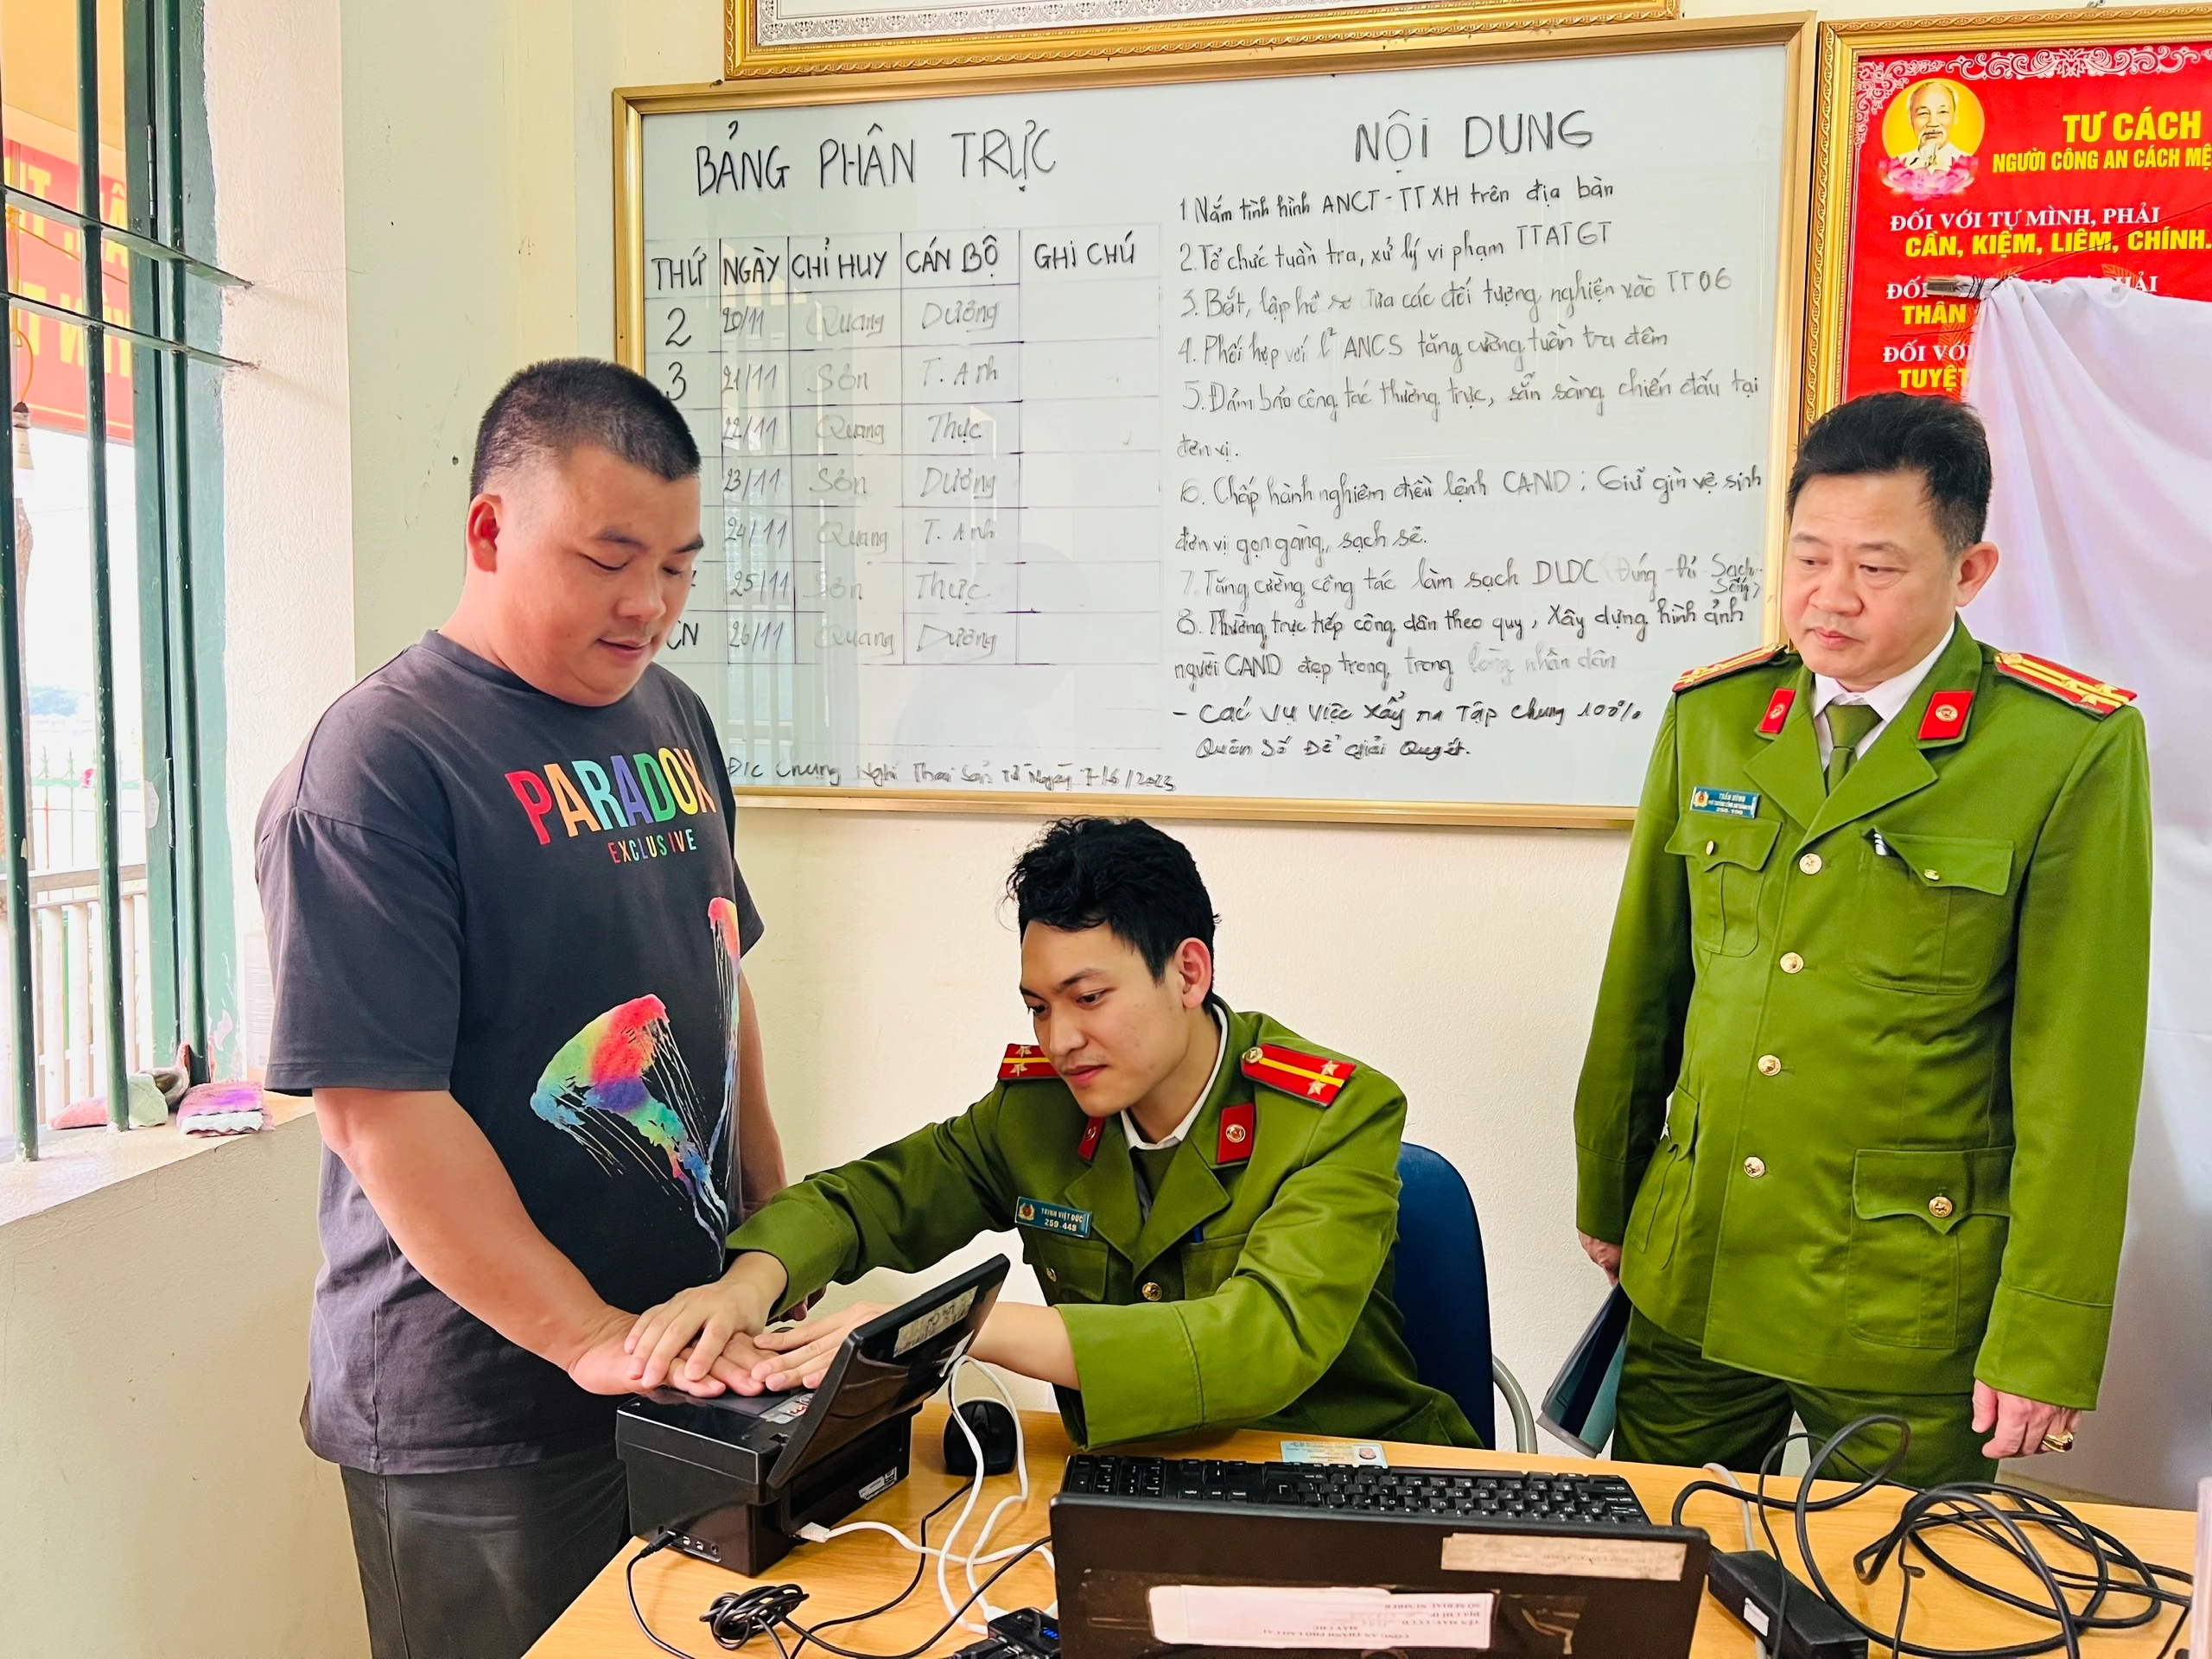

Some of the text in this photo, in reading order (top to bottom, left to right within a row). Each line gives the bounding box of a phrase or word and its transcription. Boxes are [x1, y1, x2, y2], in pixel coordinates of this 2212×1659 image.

[1355, 109, 1592, 174] NỘI DUNG
[2063, 106, 2202, 143] TƯ CÁCH
[696, 120, 1055, 195] BẢNG PHÂN TRỰC
[1993, 146, 2046, 173] NGƯỜI
[2051, 146, 2099, 171] CÔNG
[2103, 149, 2128, 169] AN
[2133, 145, 2180, 168] CÁCH
[1471, 182, 1510, 204] trên
[1527, 179, 1560, 207] địa
[1577, 175, 1613, 199] bàn
[1890, 202, 2160, 232] ĐỐI VỚI TỰ MÌNH, PHẢI
[791, 237, 887, 279] CHỈ HUY
[906, 234, 997, 277] CÁN BỘ
[1087, 231, 1135, 265] CHÚ
[1275, 241, 1317, 268] tuần
[1326, 238, 1363, 267] tra,
[1427, 244, 1443, 260] vi
[1452, 230, 1503, 271] phạm
[1905, 226, 2212, 258] CẦN, KIỆM, LIÊM, CHÍNH.
[652, 246, 707, 289] THỨ
[723, 247, 779, 285] NGÀY
[2115, 270, 2158, 292] HẢI
[1402, 283, 1435, 308] các
[1902, 301, 1966, 324] THÂN
[665, 308, 691, 346] 2
[1344, 334, 1402, 359] ANCS
[1528, 323, 1573, 351] tuần
[1583, 324, 1615, 348] tra
[1624, 325, 1668, 346] đêm
[1883, 340, 1926, 363] ĐỐI
[666, 362, 686, 400] 3
[721, 364, 776, 393] 21/11
[1344, 376, 1371, 407] tác
[1732, 368, 1758, 397] tại
[722, 416, 777, 444] 22/11
[724, 467, 779, 501] 23/11
[1267, 474, 1313, 505] hành
[1319, 472, 1384, 519] nghiêm
[1722, 464, 1762, 492] sinh
[725, 517, 787, 549] 24/11
[1338, 519, 1388, 554] sạch
[730, 570, 789, 602] 25/11
[1363, 567, 1396, 591] tác
[1411, 557, 1453, 589] làm
[1465, 557, 1519, 592] sạch
[1403, 613, 1438, 632] dân
[1445, 608, 1482, 630] theo
[1657, 598, 1696, 625] hình
[1704, 597, 1744, 625] ảnh
[728, 620, 784, 652] 26/11
[1224, 653, 1282, 677] CAND
[504, 747, 717, 845] PARADOX
[607, 828, 697, 864] EXCLUSIVE
